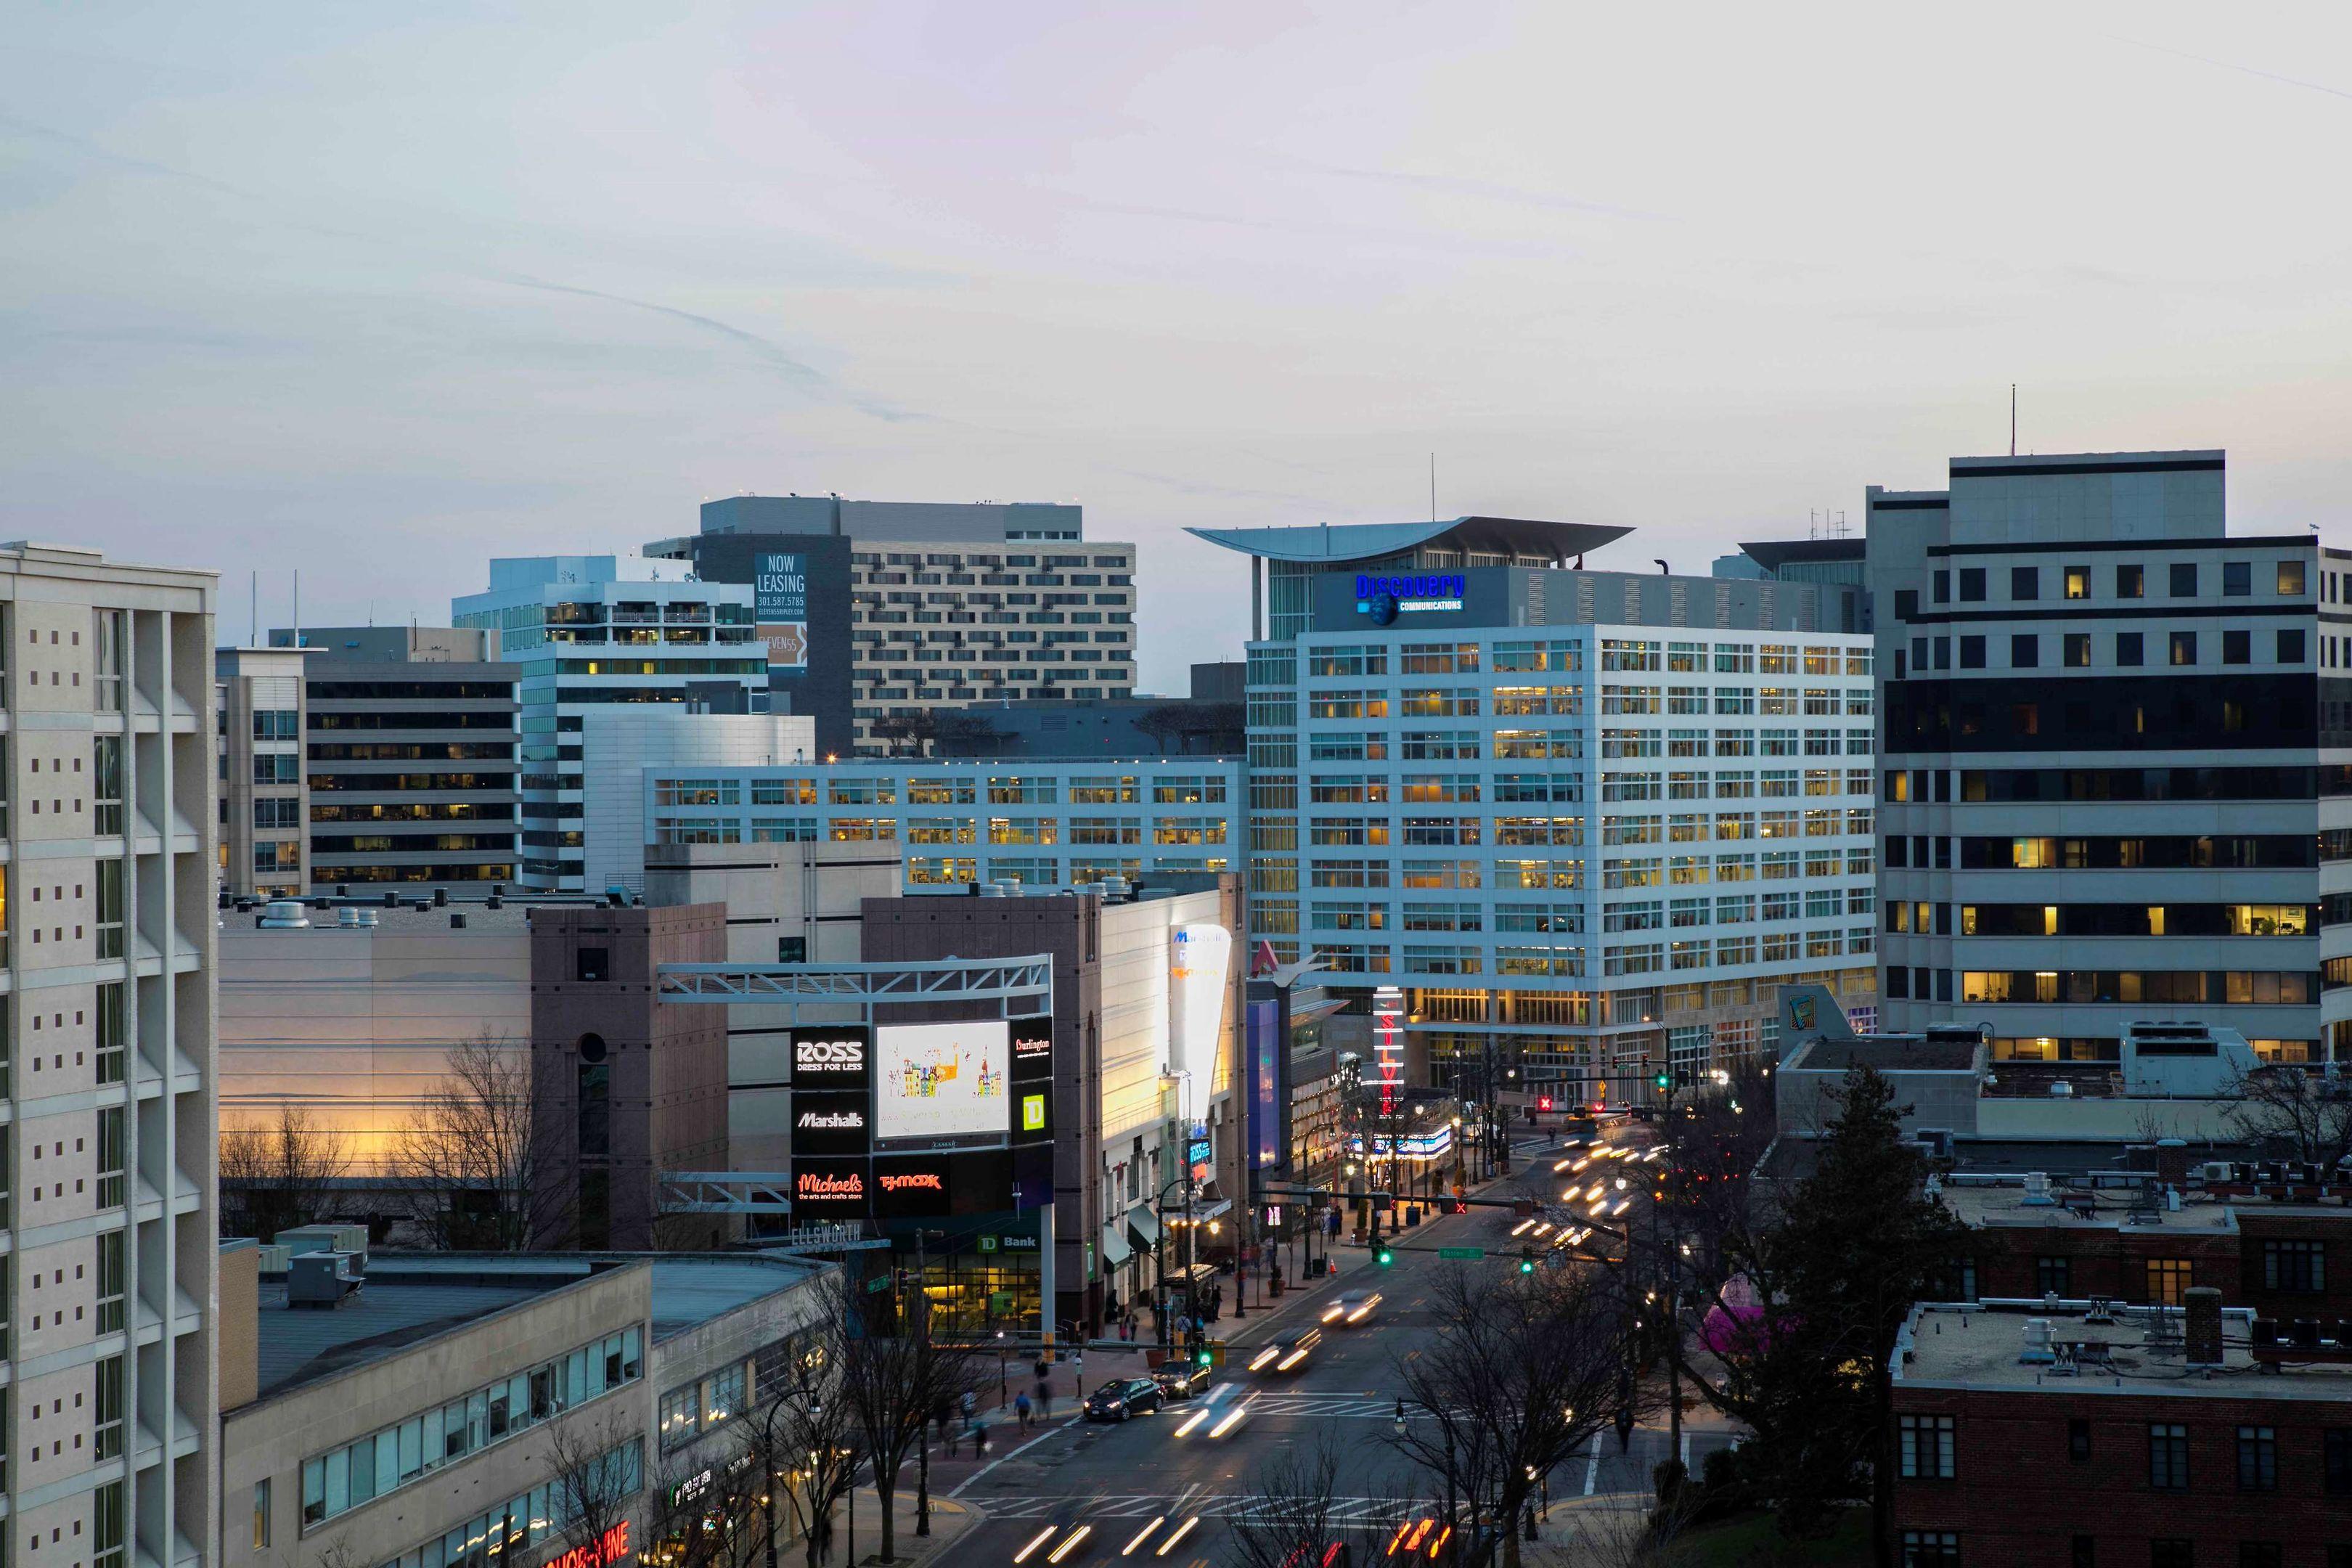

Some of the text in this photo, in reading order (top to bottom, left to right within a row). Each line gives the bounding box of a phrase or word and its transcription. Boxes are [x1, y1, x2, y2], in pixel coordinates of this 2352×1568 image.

[768, 555, 794, 572] NOW
[758, 574, 804, 592] LEASING
[1356, 574, 1465, 599] Discovery
[758, 597, 804, 606] 301.587.5785
[1400, 600, 1461, 611] COMMUNICATIONS
[797, 1042, 862, 1062] ROSS
[1016, 1039, 1049, 1051] Burlington
[798, 1112, 863, 1127] Marshalls
[1024, 1100, 1043, 1124] TD
[798, 1173, 863, 1192] Michaels
[791, 1223, 860, 1246] ELLSWORTH
[981, 1237, 1036, 1250] TD Bank
